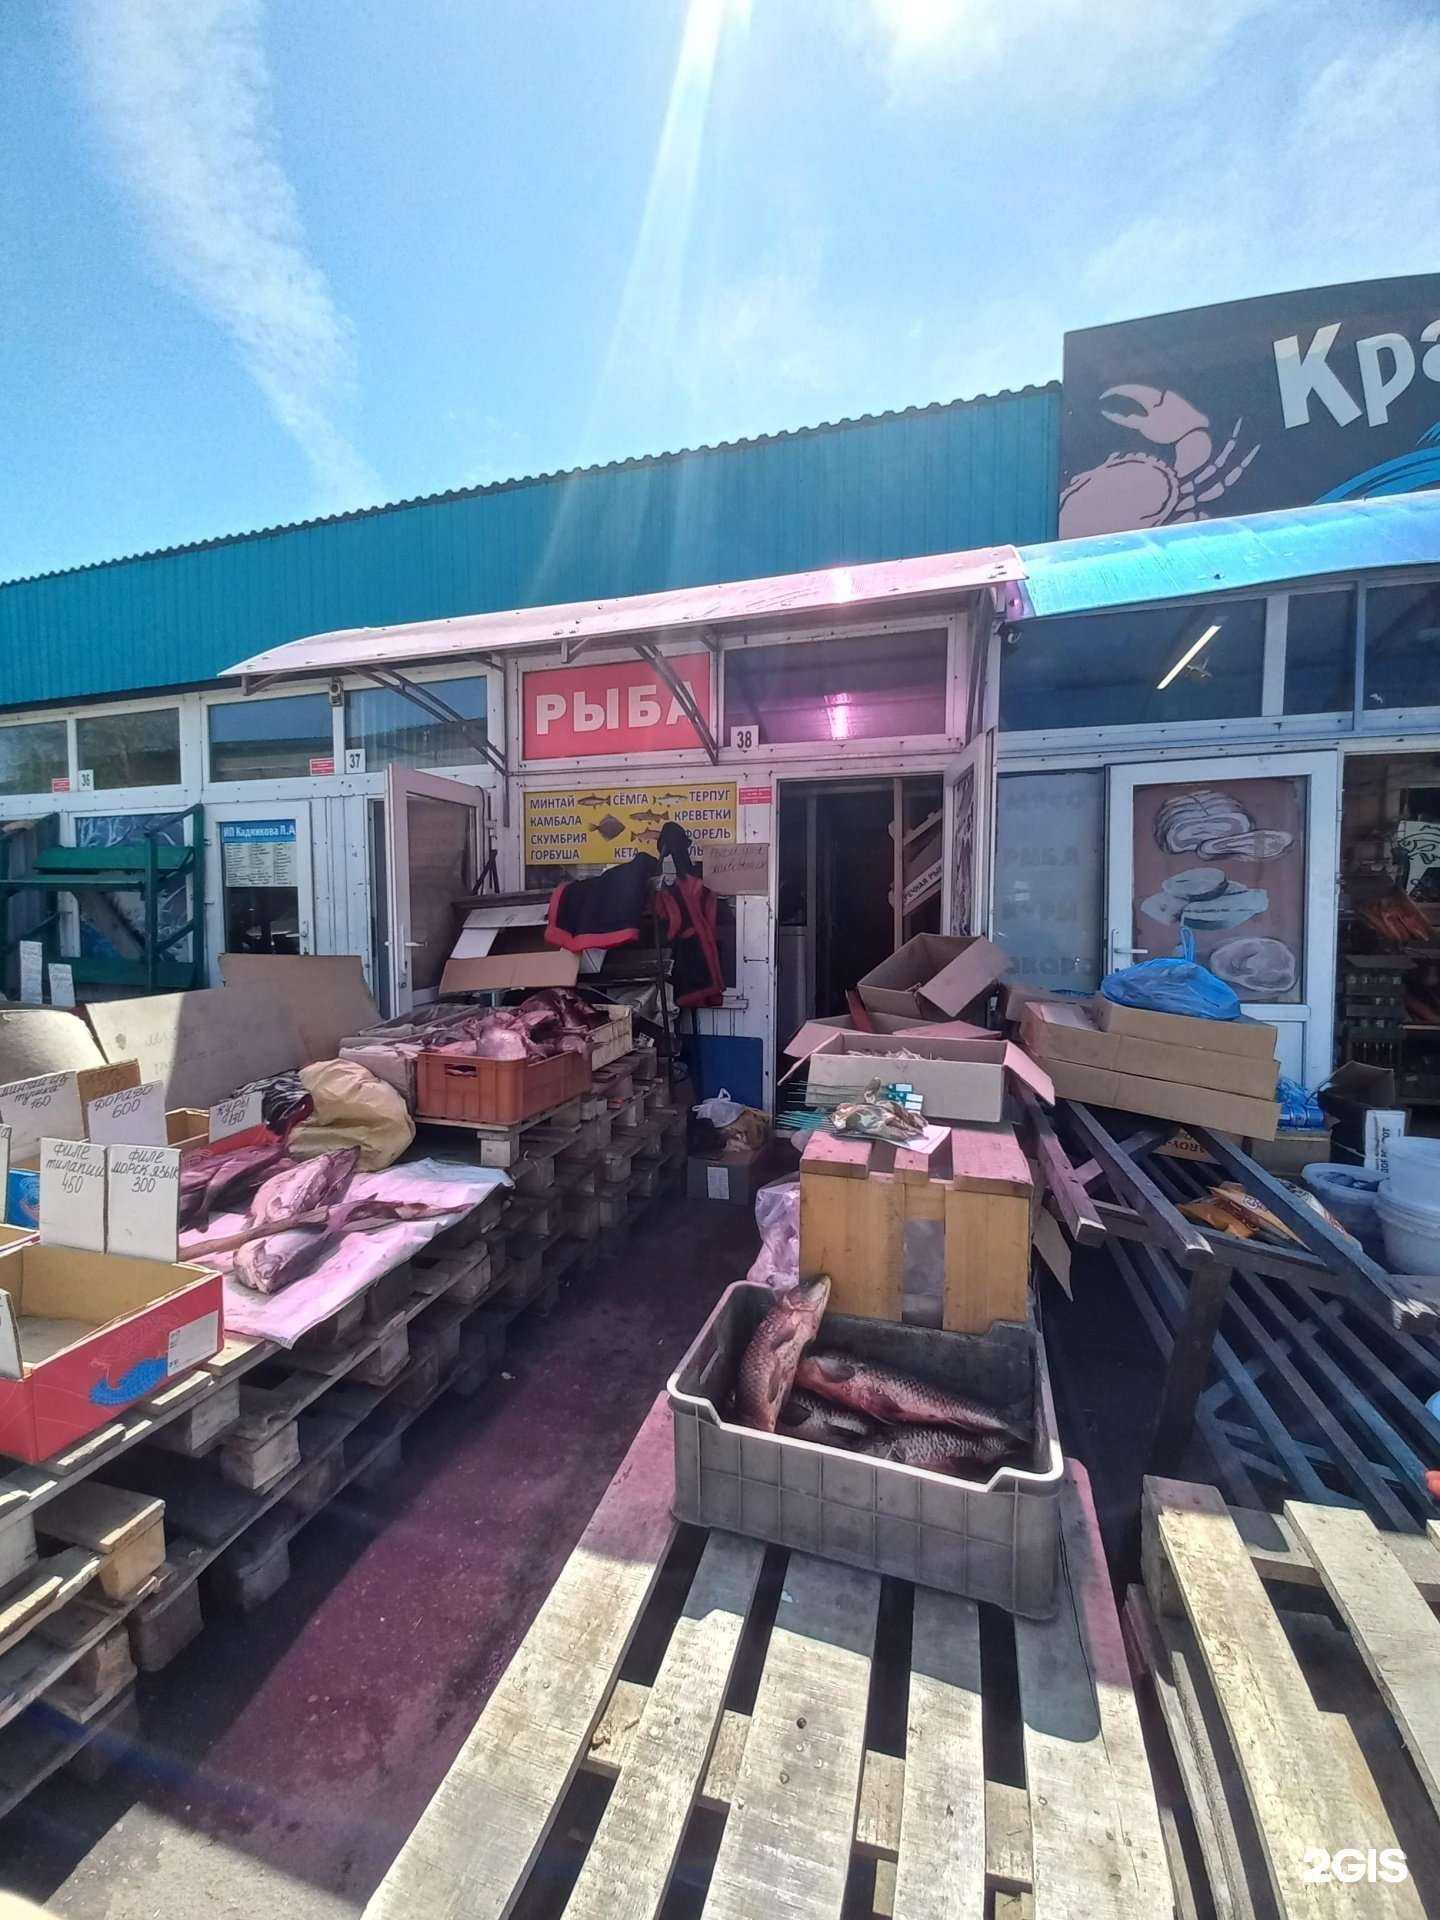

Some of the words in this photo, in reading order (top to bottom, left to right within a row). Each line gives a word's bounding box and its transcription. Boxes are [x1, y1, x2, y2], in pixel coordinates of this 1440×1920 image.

[736, 730, 752, 749] 38
[349, 753, 361, 769] 37
[530, 795, 575, 809] МИНТАЙ
[613, 792, 649, 806] СЁМГА
[688, 789, 730, 802] ТЕРПУГ
[530, 815, 582, 827] КАМБАЛА
[674, 809, 731, 821] КРЕВЕТКИ
[530, 832, 587, 845] СКУМБРИЯ
[530, 849, 579, 861] ГОРБУША
[614, 847, 640, 859] КЕТА
[112, 1099, 140, 1119] 600
[61, 1173, 83, 1194] 450
[131, 1176, 156, 1193] 300
